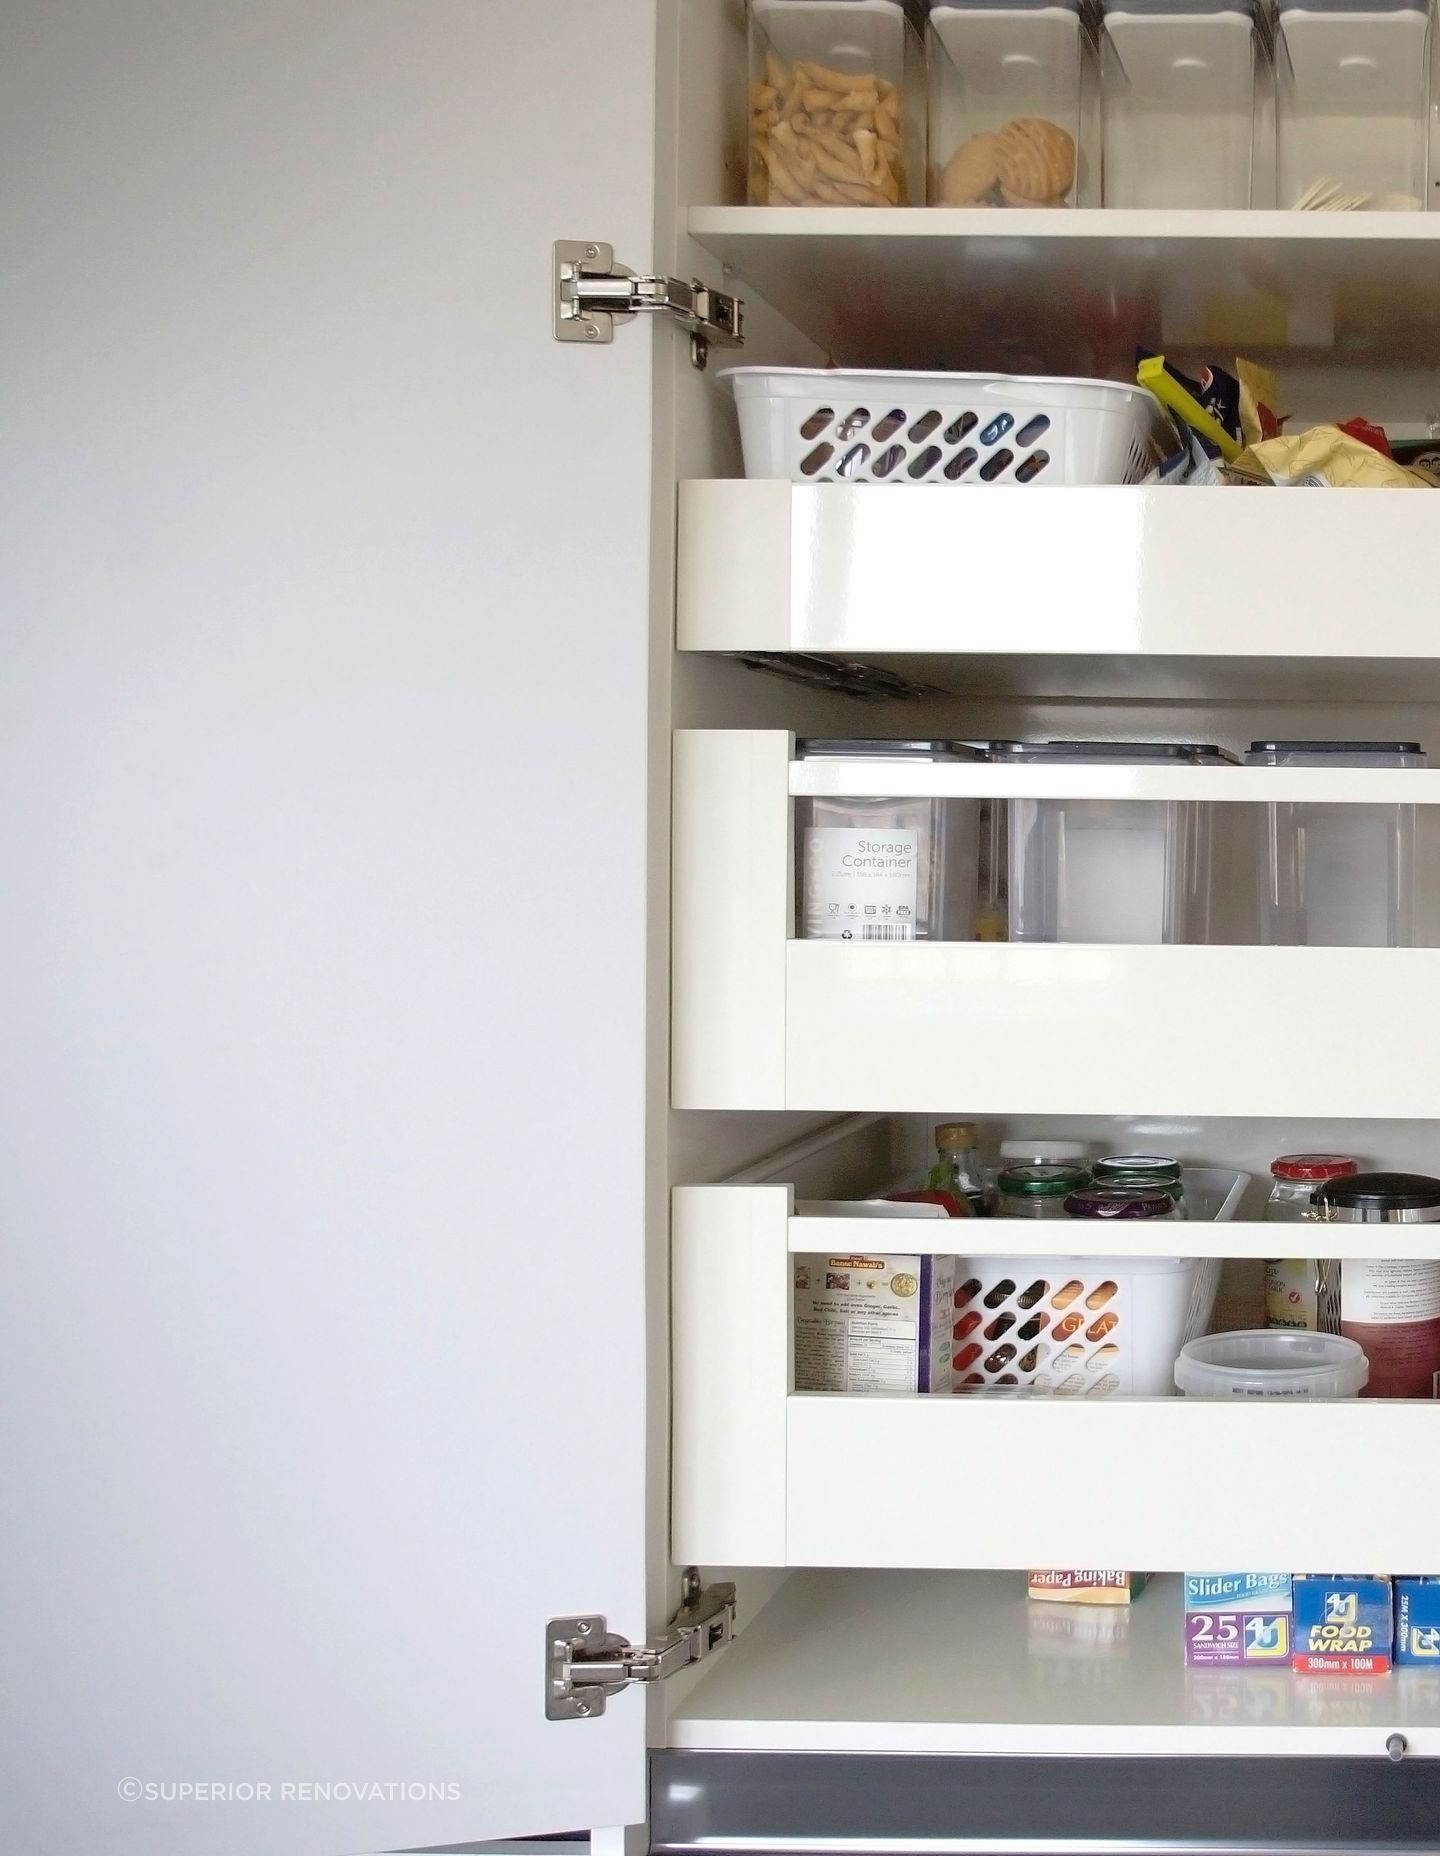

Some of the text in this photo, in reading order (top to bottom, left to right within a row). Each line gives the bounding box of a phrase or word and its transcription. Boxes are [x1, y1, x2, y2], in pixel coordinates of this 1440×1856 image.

[858, 841, 912, 856] Storage
[842, 855, 912, 868] Container
[1031, 1570, 1126, 1587] Baking Paper
[1188, 1578, 1241, 1596] Slider
[1246, 1573, 1288, 1589] Bags
[1401, 1594, 1409, 1612] 25M
[1191, 1615, 1238, 1641] 25
[1310, 1625, 1372, 1638] FOOD
[1400, 1622, 1409, 1652] 300mm
[1308, 1639, 1373, 1652] WRAP
[1308, 1657, 1374, 1670] 300mm x 100M
